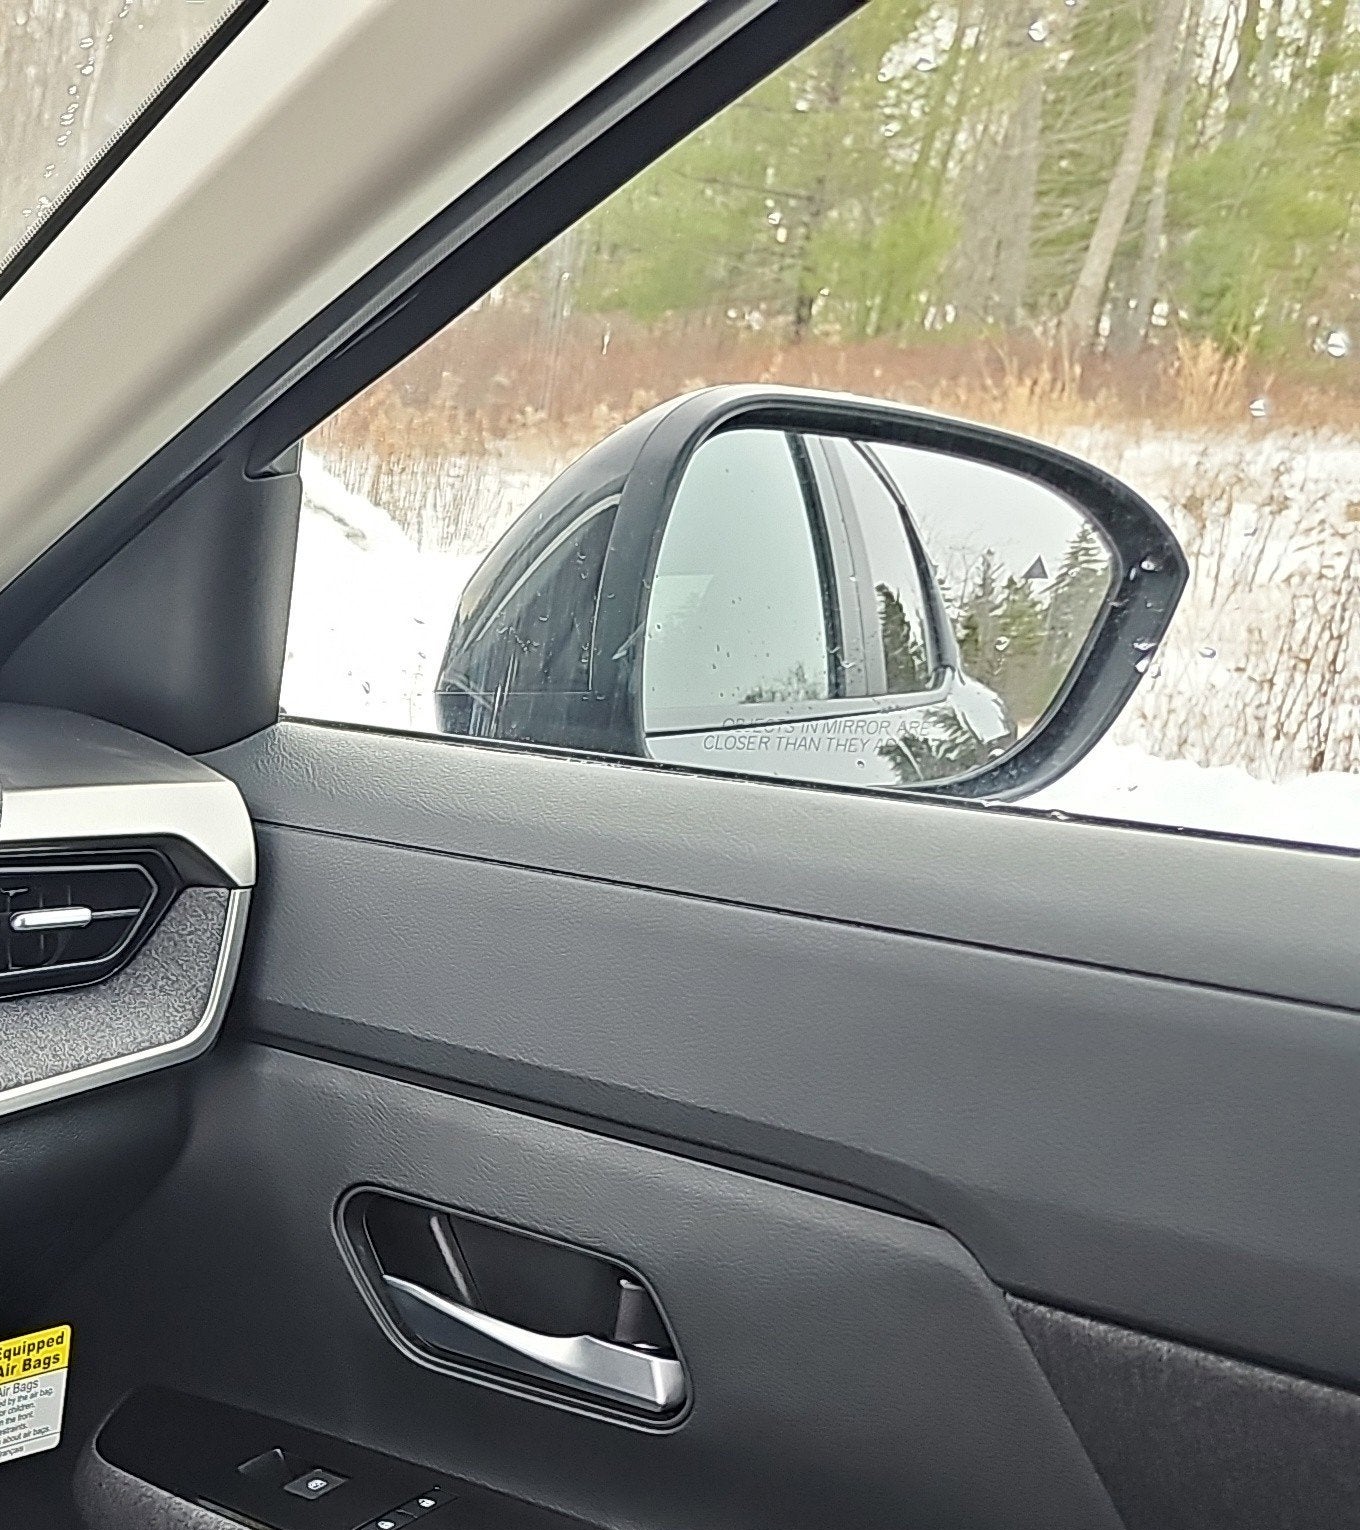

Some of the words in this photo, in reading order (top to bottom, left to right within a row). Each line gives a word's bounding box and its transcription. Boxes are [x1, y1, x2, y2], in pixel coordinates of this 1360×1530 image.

[822, 720, 890, 735] MIRROR
[704, 735, 770, 751] CLOSER
[777, 736, 822, 751] THAN
[829, 737, 870, 752] THEY
[22, 1353, 60, 1373] Bags
[13, 1380, 39, 1394] Bags
